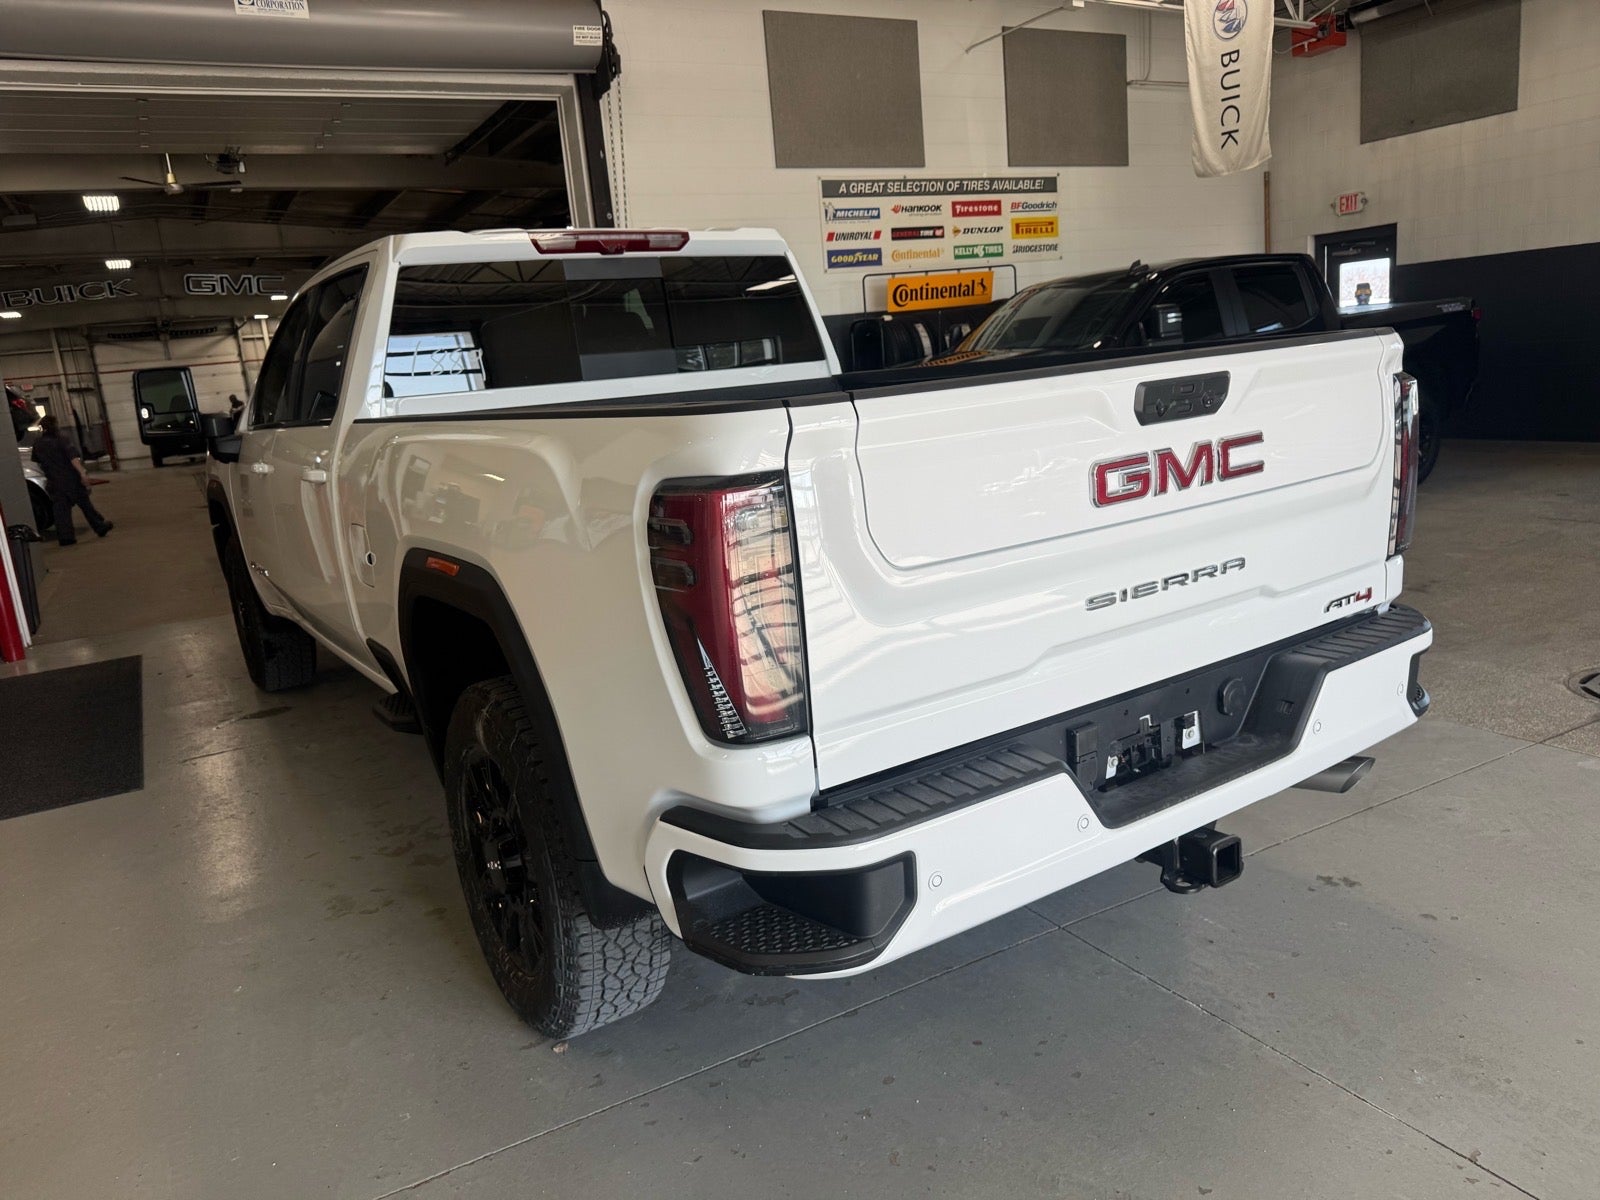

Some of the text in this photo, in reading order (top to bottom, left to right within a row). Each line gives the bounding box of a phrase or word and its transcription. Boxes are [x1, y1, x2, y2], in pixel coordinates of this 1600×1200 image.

[255, 0, 305, 10] CORPORATION
[1220, 49, 1240, 150] BUICK
[839, 179, 1044, 194] A GREAT SELECTION OF TIRES AVAILABLE!
[955, 205, 998, 214] Firestone
[1010, 201, 1057, 210] BFGoodrich
[1339, 193, 1359, 213] EXIT
[835, 209, 879, 218] MICHELIN
[962, 226, 1003, 235] DUNLOP
[1014, 221, 1054, 235] PIRELLI
[835, 231, 872, 241] UNIROYAL
[891, 248, 940, 262] Continental
[954, 246, 975, 256] KELLY
[985, 245, 1003, 254] TIRES
[1012, 243, 1058, 253] BRIDGESTONE
[832, 252, 879, 264] GOODYEAR
[184, 273, 287, 296] GMC
[1, 278, 138, 310] BUICK
[892, 279, 975, 308] Continental
[1088, 429, 1265, 508] GMC
[1085, 556, 1246, 612] SIERRA
[1323, 586, 1372, 613] AT4
